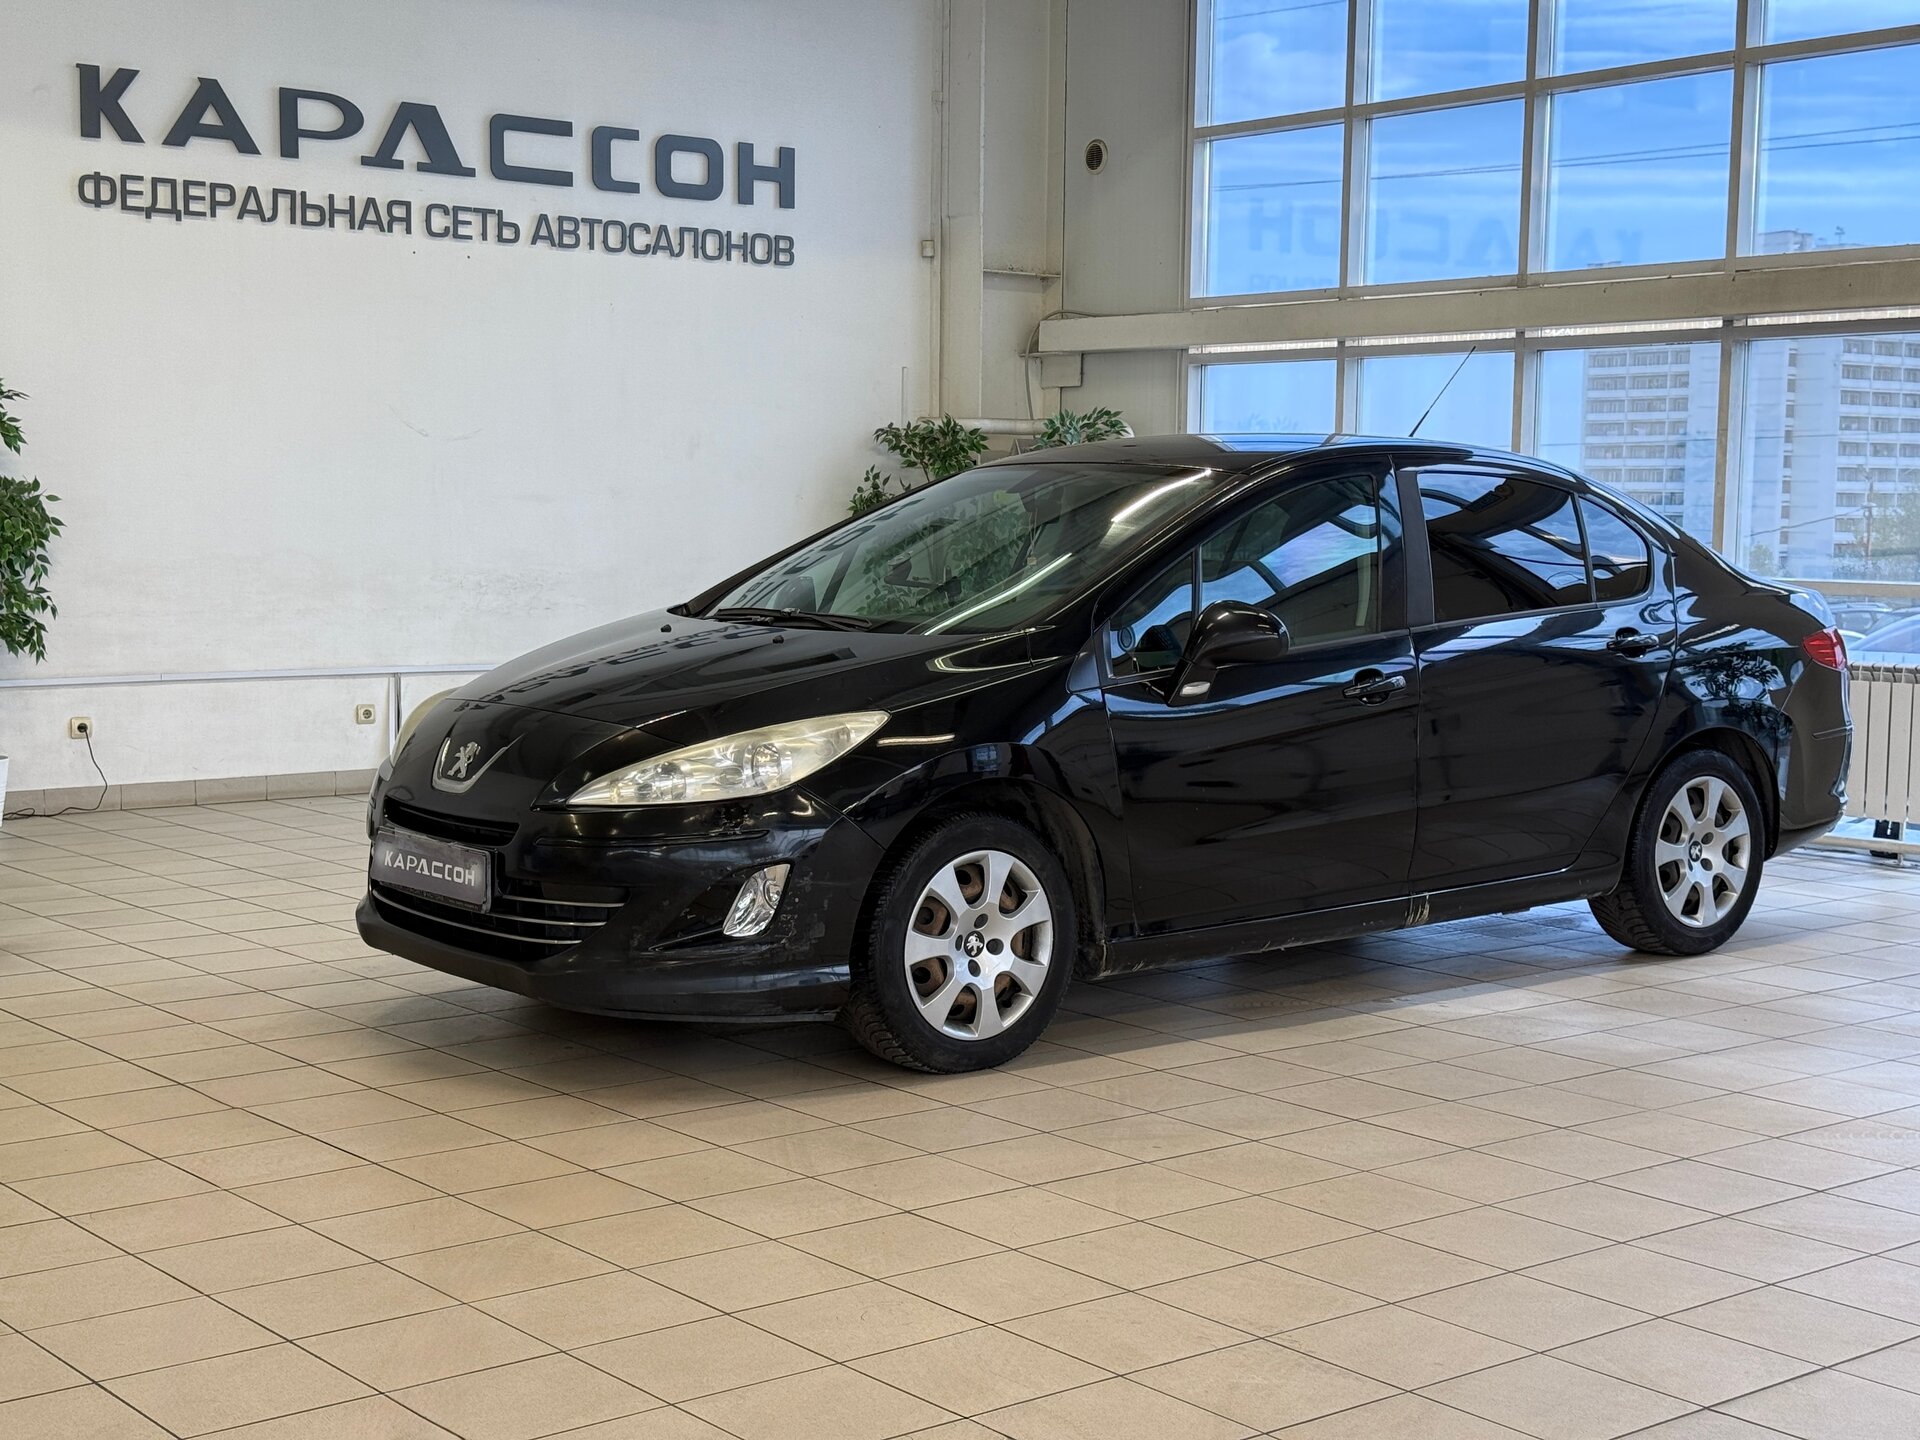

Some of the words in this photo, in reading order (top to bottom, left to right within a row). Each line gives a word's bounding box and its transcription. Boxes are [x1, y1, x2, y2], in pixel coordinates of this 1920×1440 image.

[77, 171, 412, 236] ФЕДЕРАЛЬНАЯ
[424, 203, 521, 244] СЕТЬ
[530, 213, 795, 267] АВТОСАЛОНОВ
